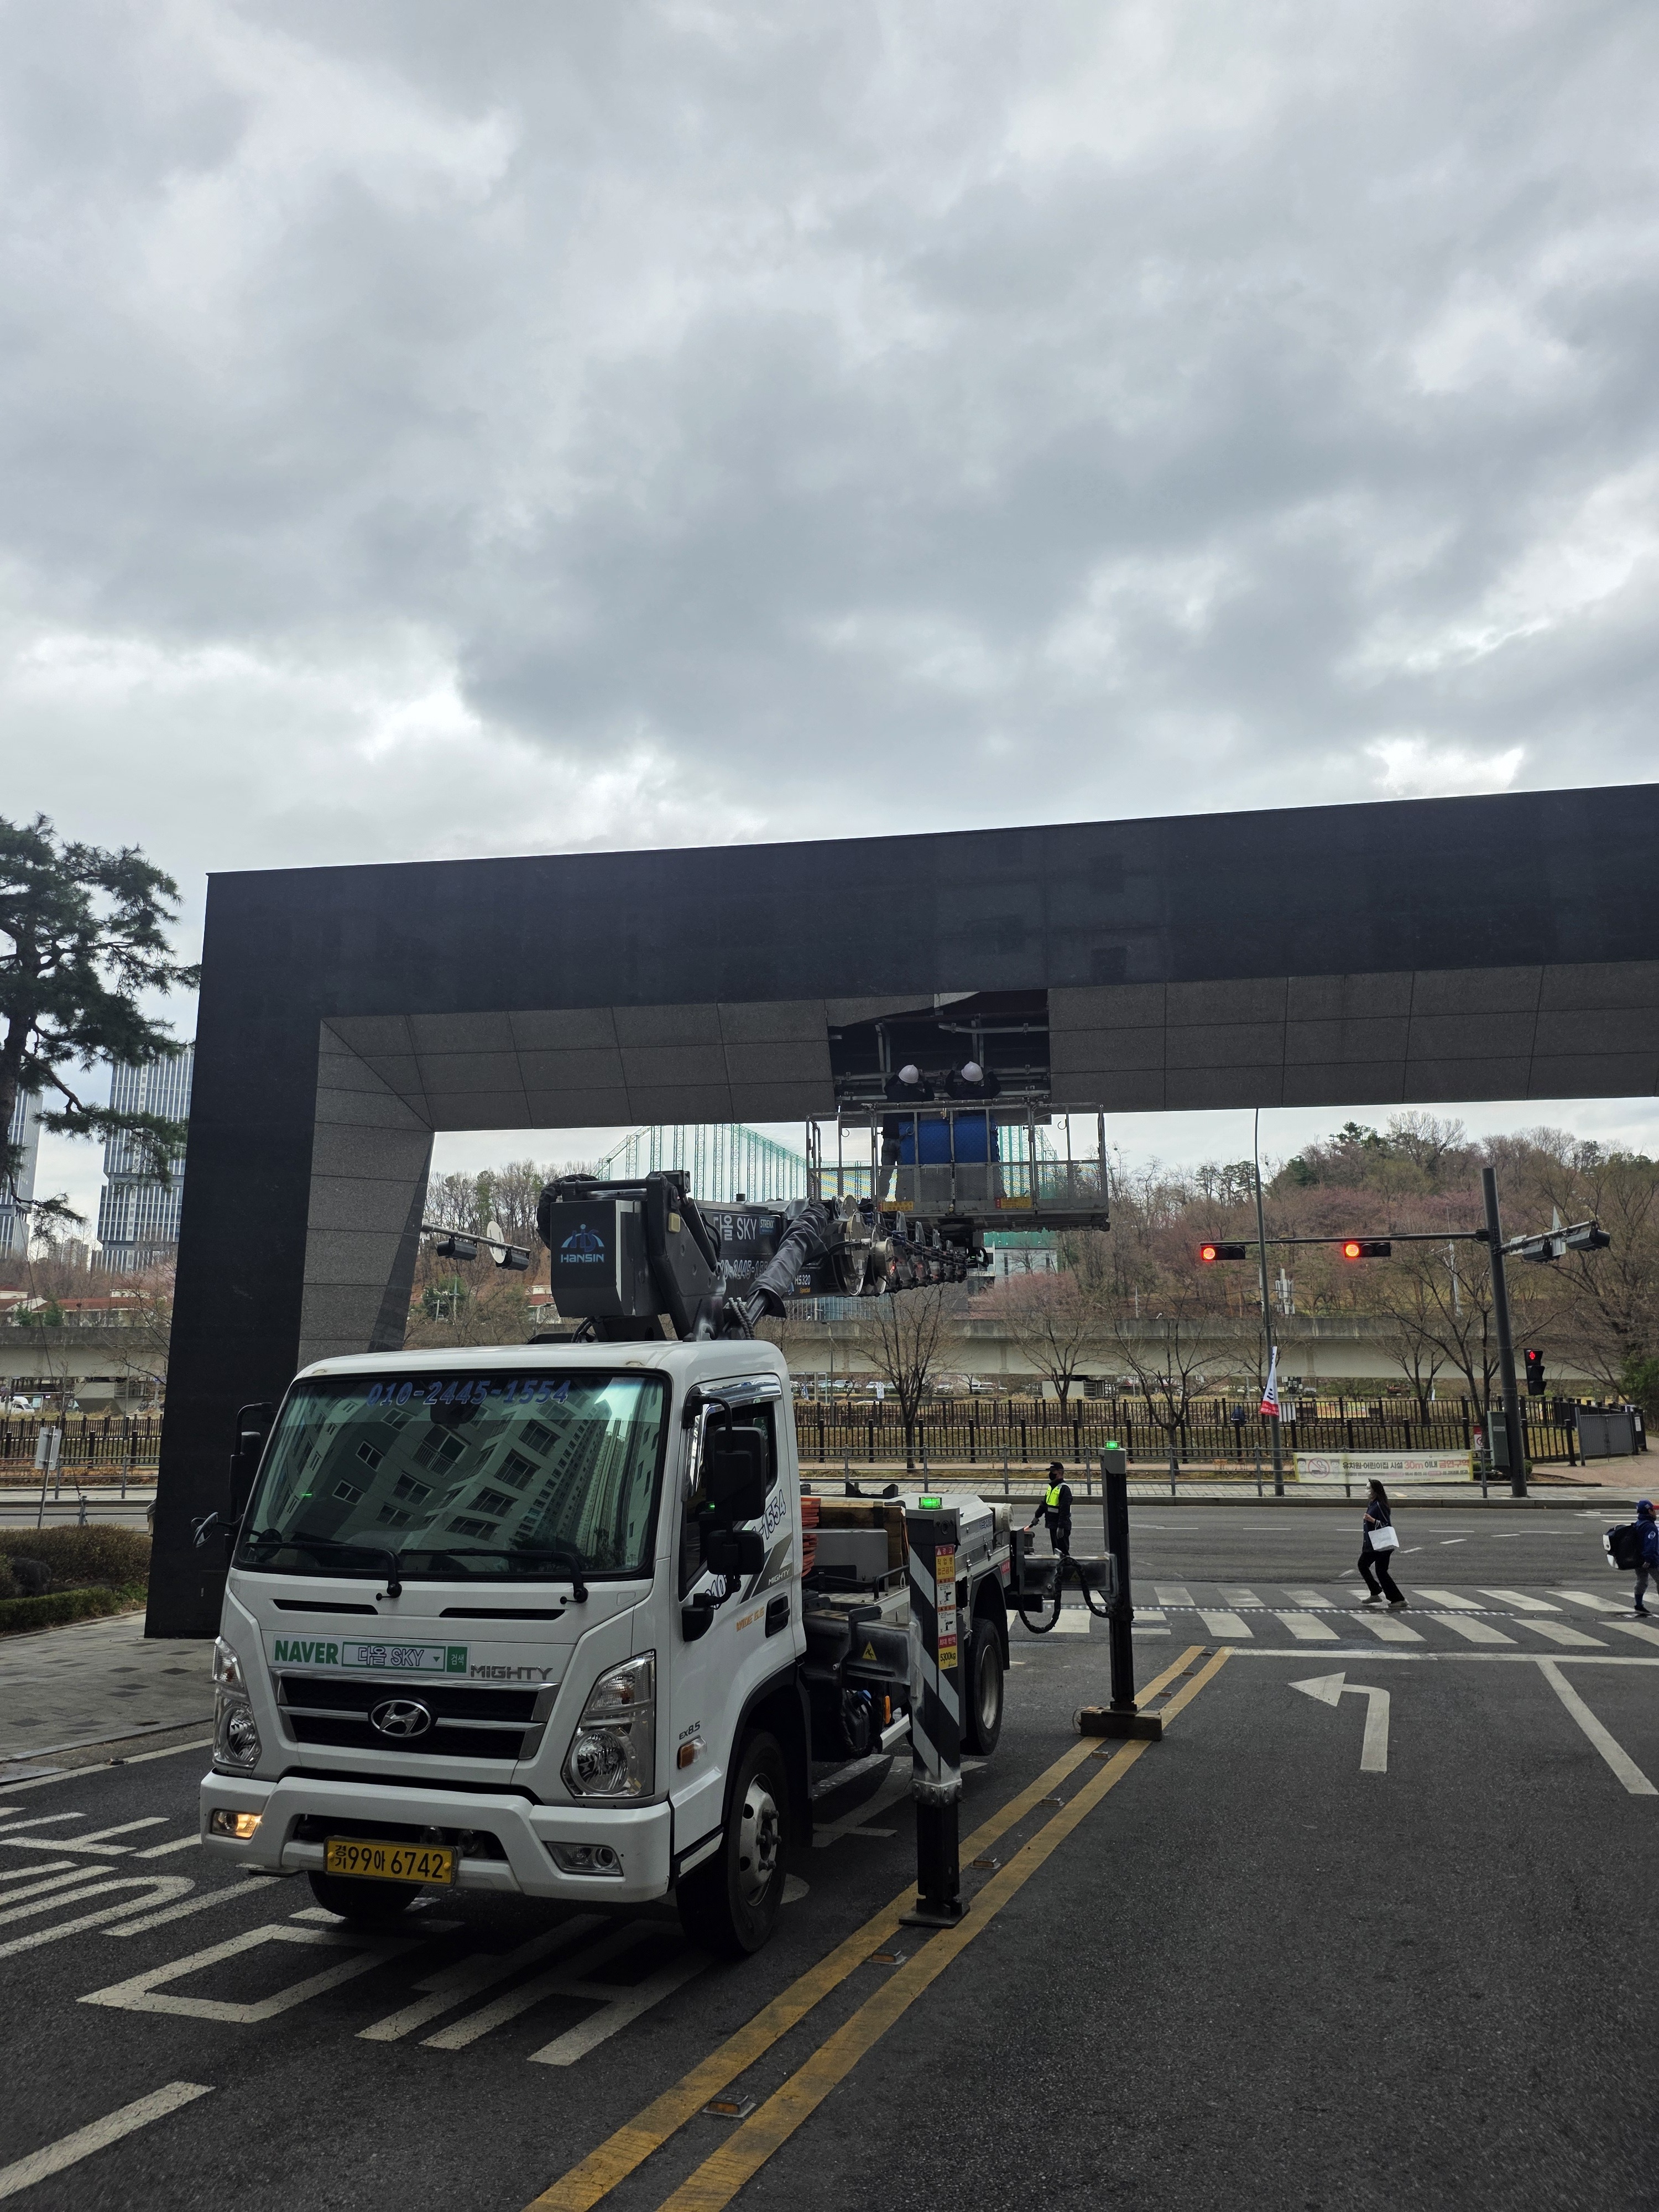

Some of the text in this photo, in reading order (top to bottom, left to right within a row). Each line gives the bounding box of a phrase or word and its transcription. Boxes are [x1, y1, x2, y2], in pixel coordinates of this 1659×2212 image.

[737, 1217, 757, 1240] SKY
[366, 1380, 571, 1406] 010-2445-1554
[1404, 1460, 1423, 1469] 30m
[1439, 1459, 1470, 1469] 금연구역
[768, 1568, 790, 1586] MIGHTY
[736, 1614, 753, 1632] WIDE
[275, 1640, 339, 1665] NAVER
[358, 1645, 425, 1667] 다올 SKY
[451, 1653, 465, 1666] 검색
[471, 1665, 554, 1681] MIGHTY
[335, 1844, 347, 1870] 경기
[390, 1850, 444, 1879] 6742
